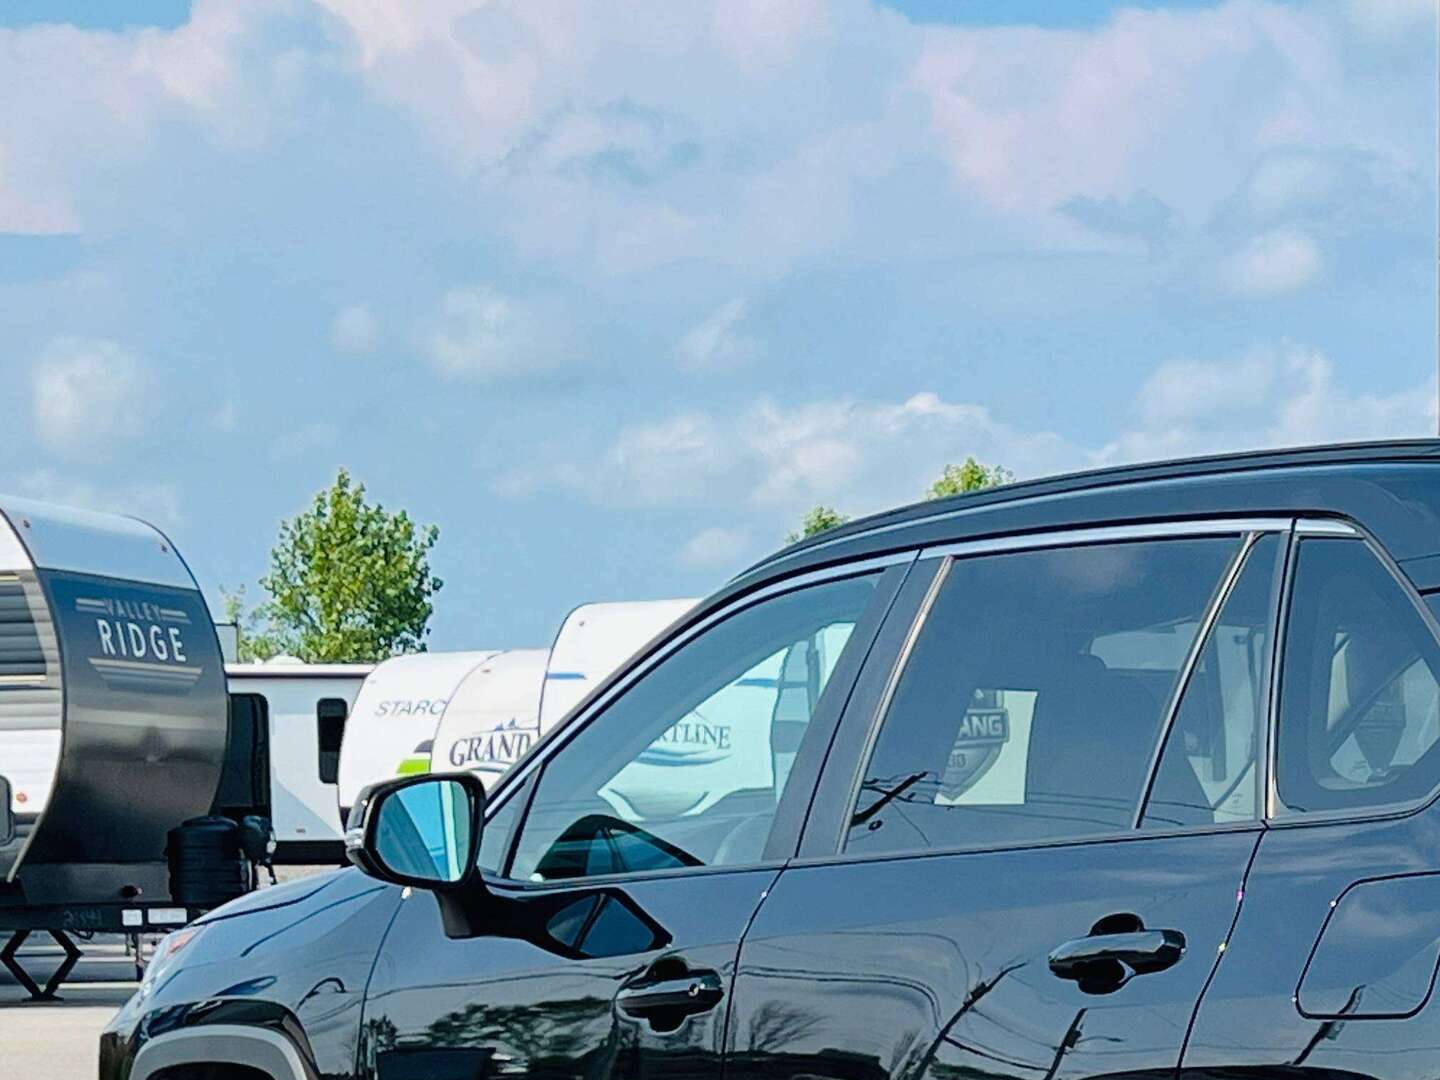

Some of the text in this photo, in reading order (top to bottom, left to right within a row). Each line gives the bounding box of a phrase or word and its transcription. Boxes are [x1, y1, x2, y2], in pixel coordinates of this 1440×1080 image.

[103, 598, 161, 620] VALLEY
[97, 619, 186, 662] RIDGE
[450, 732, 531, 767] GRAND
